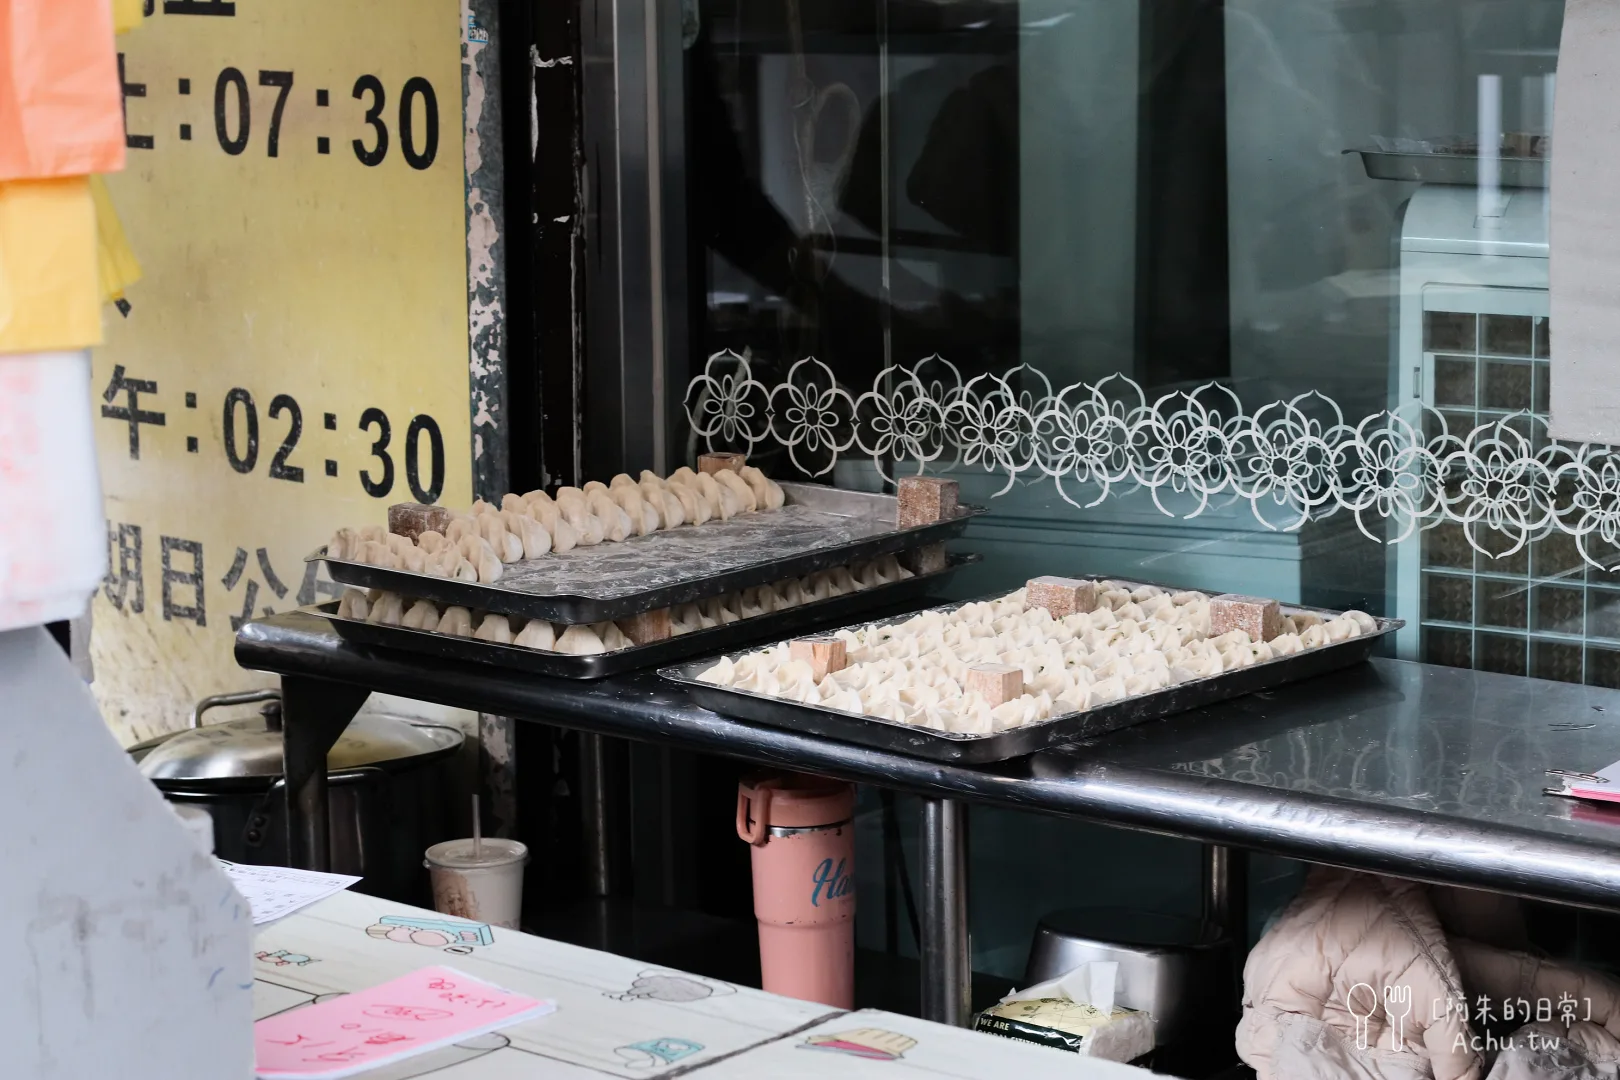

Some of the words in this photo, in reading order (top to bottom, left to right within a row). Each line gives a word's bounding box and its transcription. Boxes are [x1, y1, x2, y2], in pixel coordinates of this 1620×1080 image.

[811, 857, 854, 908] Ha
[980, 1017, 993, 1027] WE
[993, 1020, 1010, 1031] ARE
